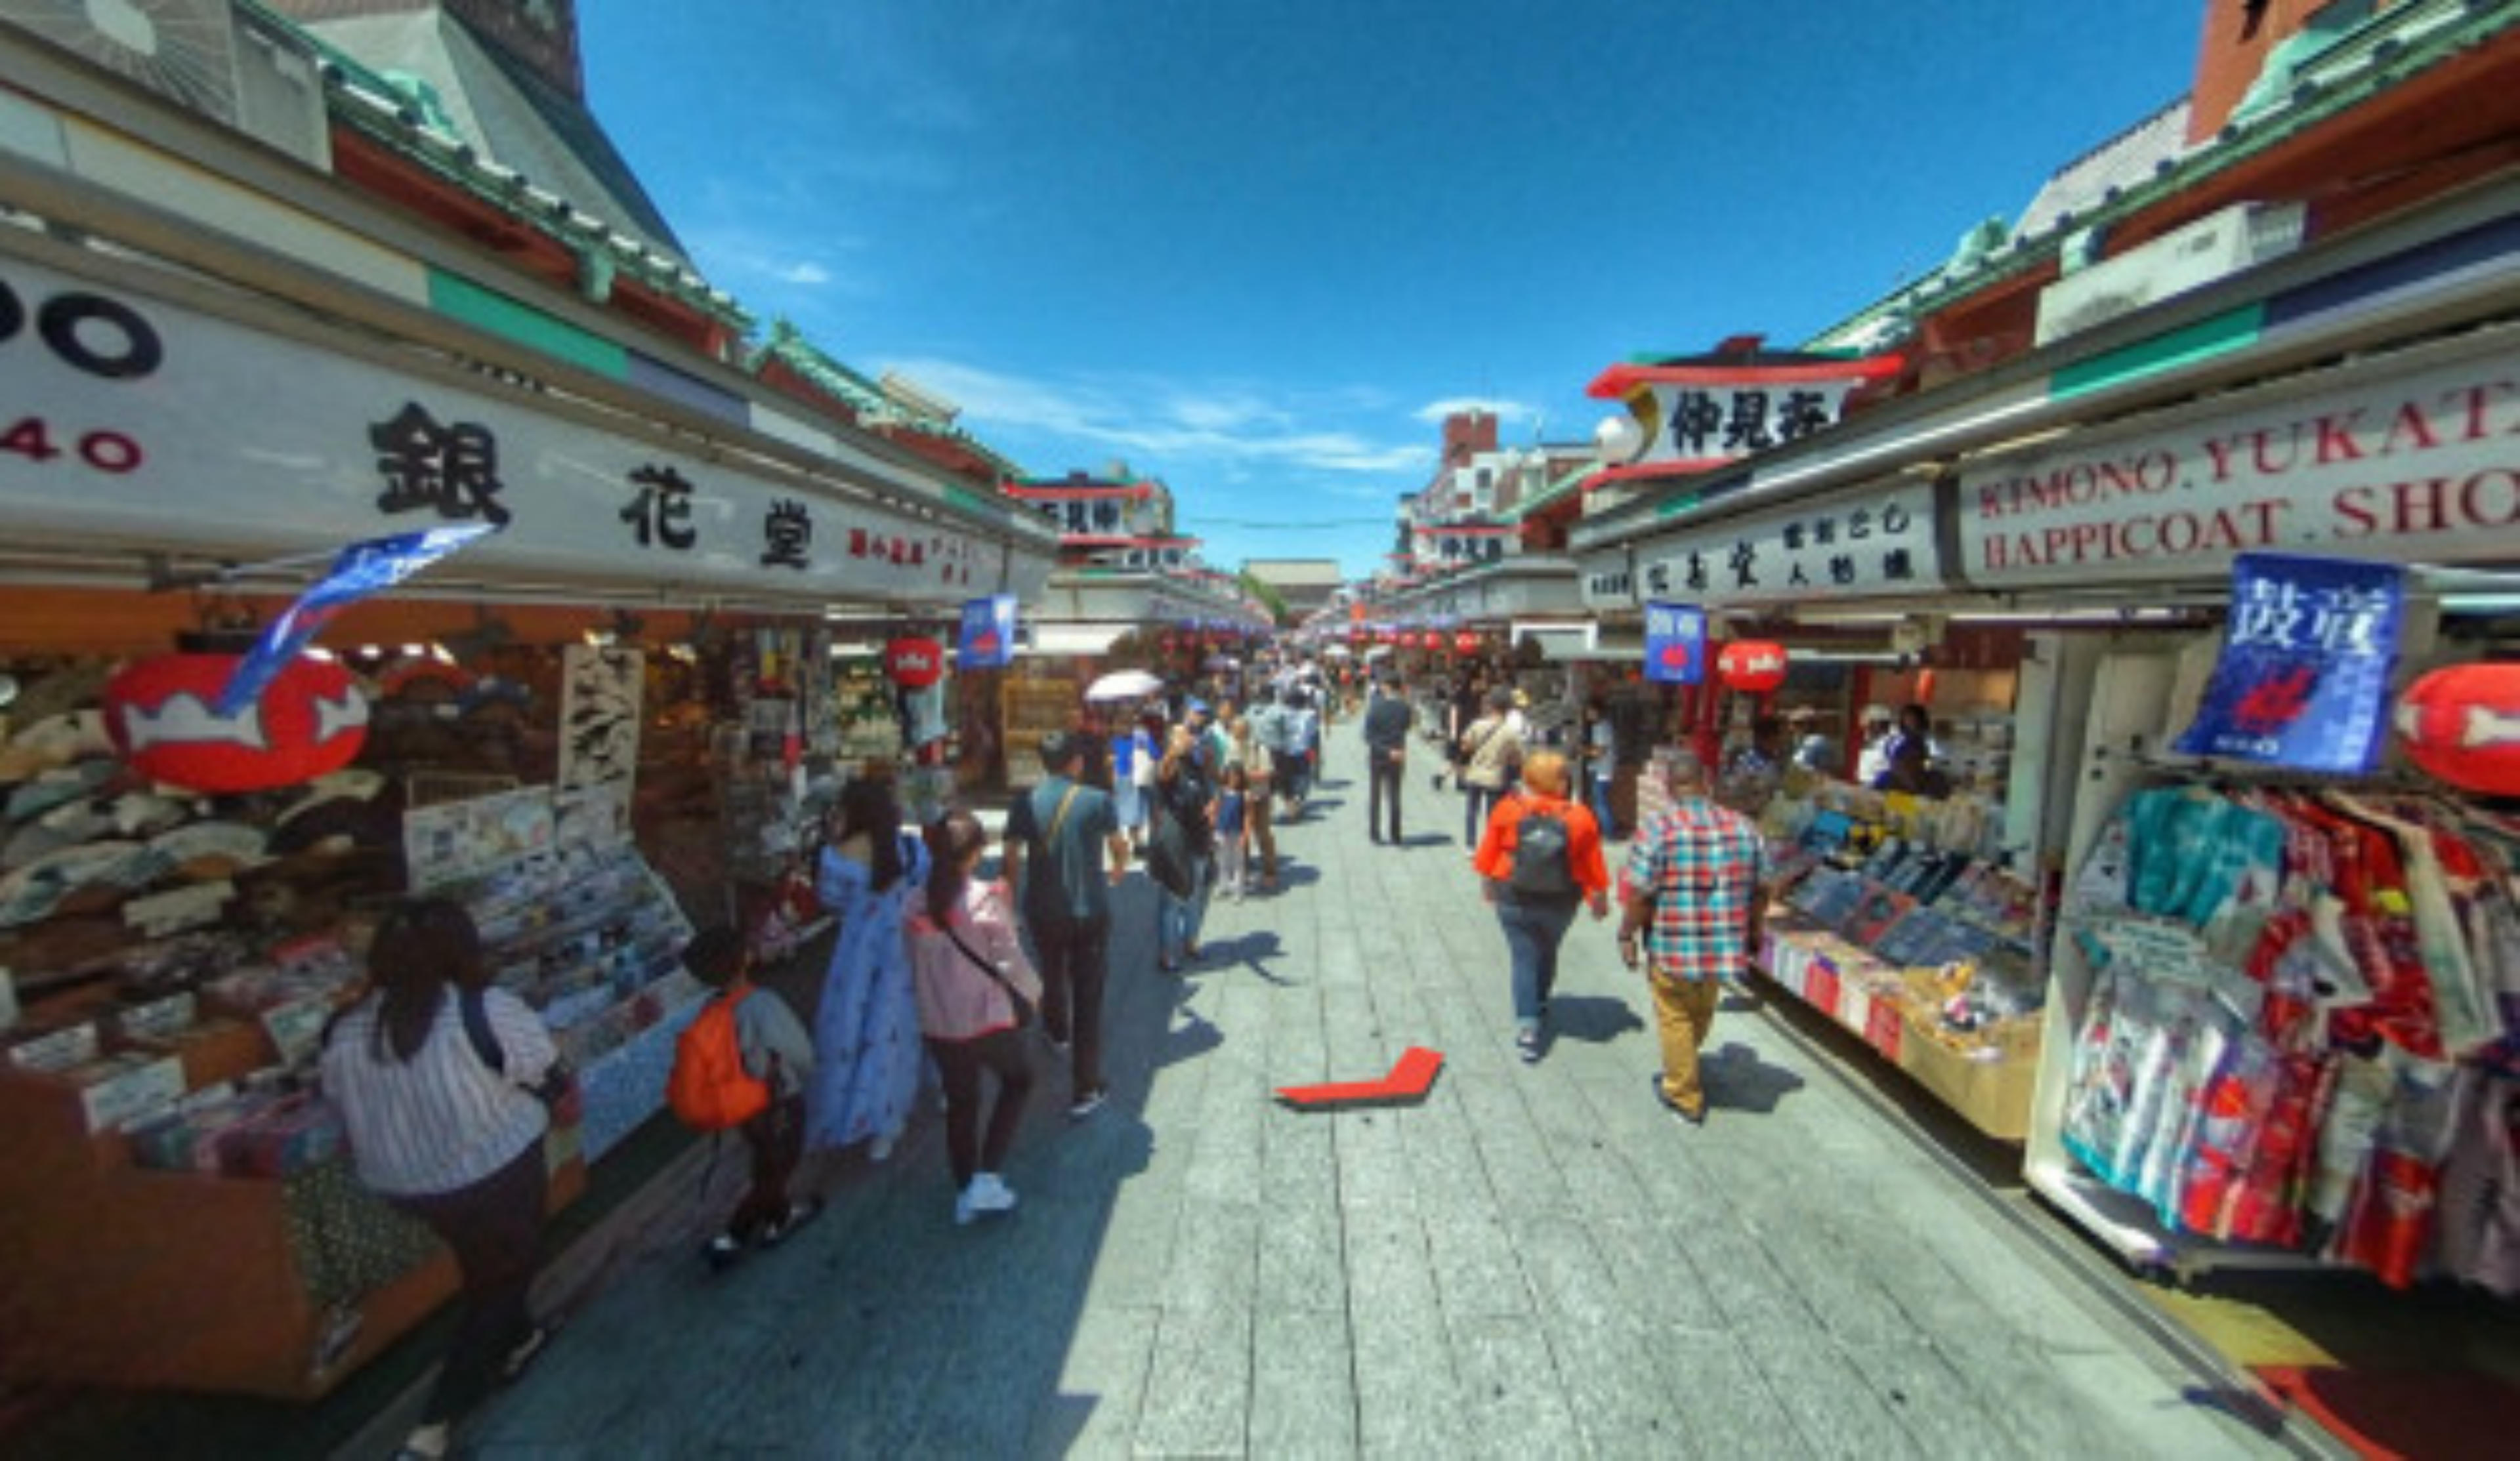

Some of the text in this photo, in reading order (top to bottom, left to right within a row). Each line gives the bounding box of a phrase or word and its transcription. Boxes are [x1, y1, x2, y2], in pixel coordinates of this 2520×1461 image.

[0, 279, 163, 381] O
[2203, 381, 2520, 482] YUKAT
[369, 401, 812, 569] 銀花堂
